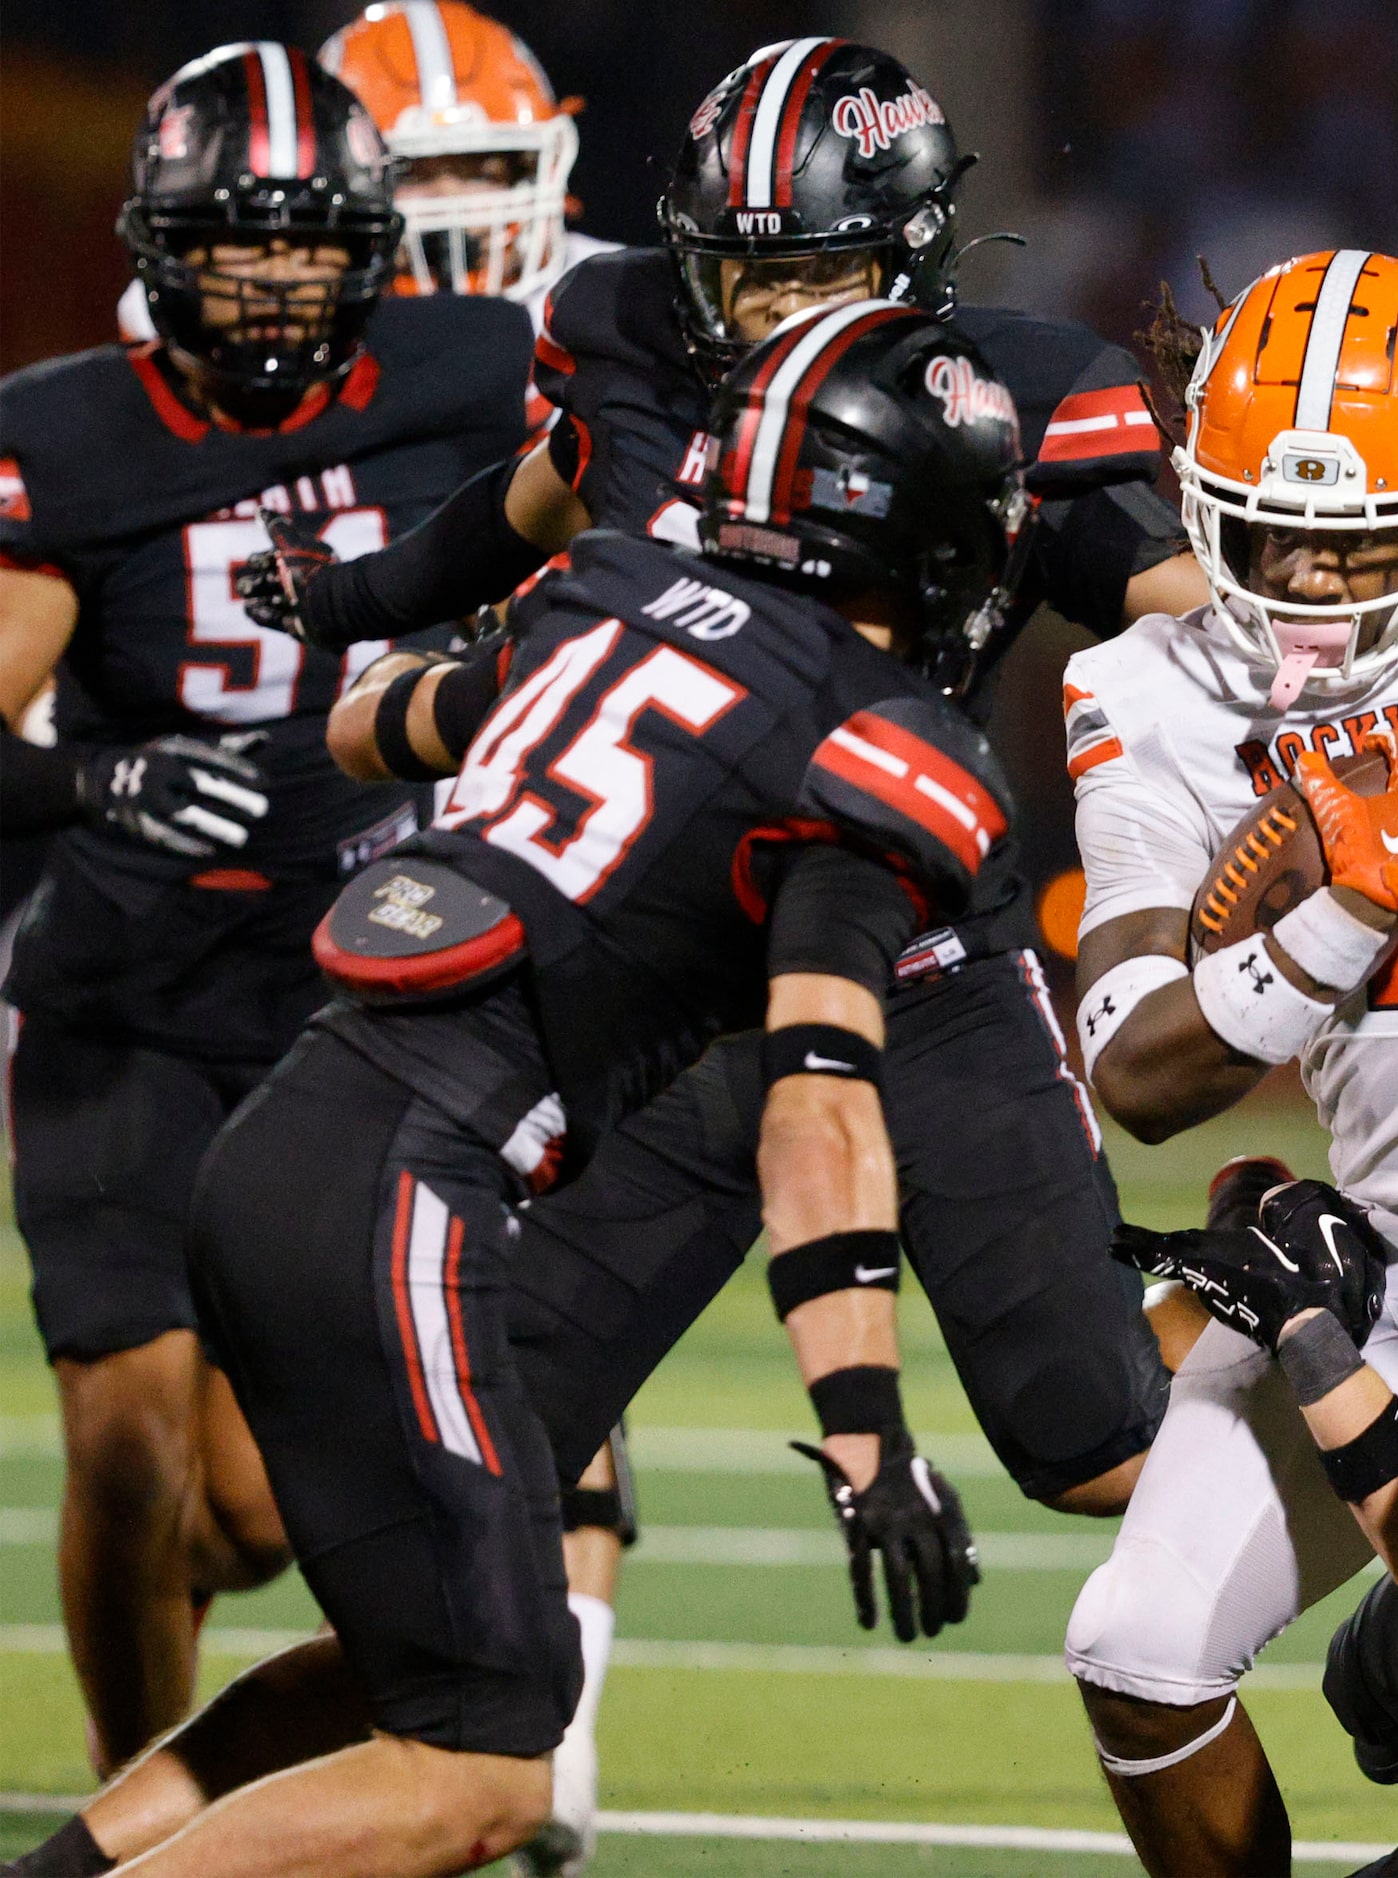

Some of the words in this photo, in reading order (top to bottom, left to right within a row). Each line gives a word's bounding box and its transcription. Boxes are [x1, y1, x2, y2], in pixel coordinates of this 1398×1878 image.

[735, 212, 782, 235] WTD
[640, 577, 750, 641] WTD
[432, 616, 750, 906] 45
